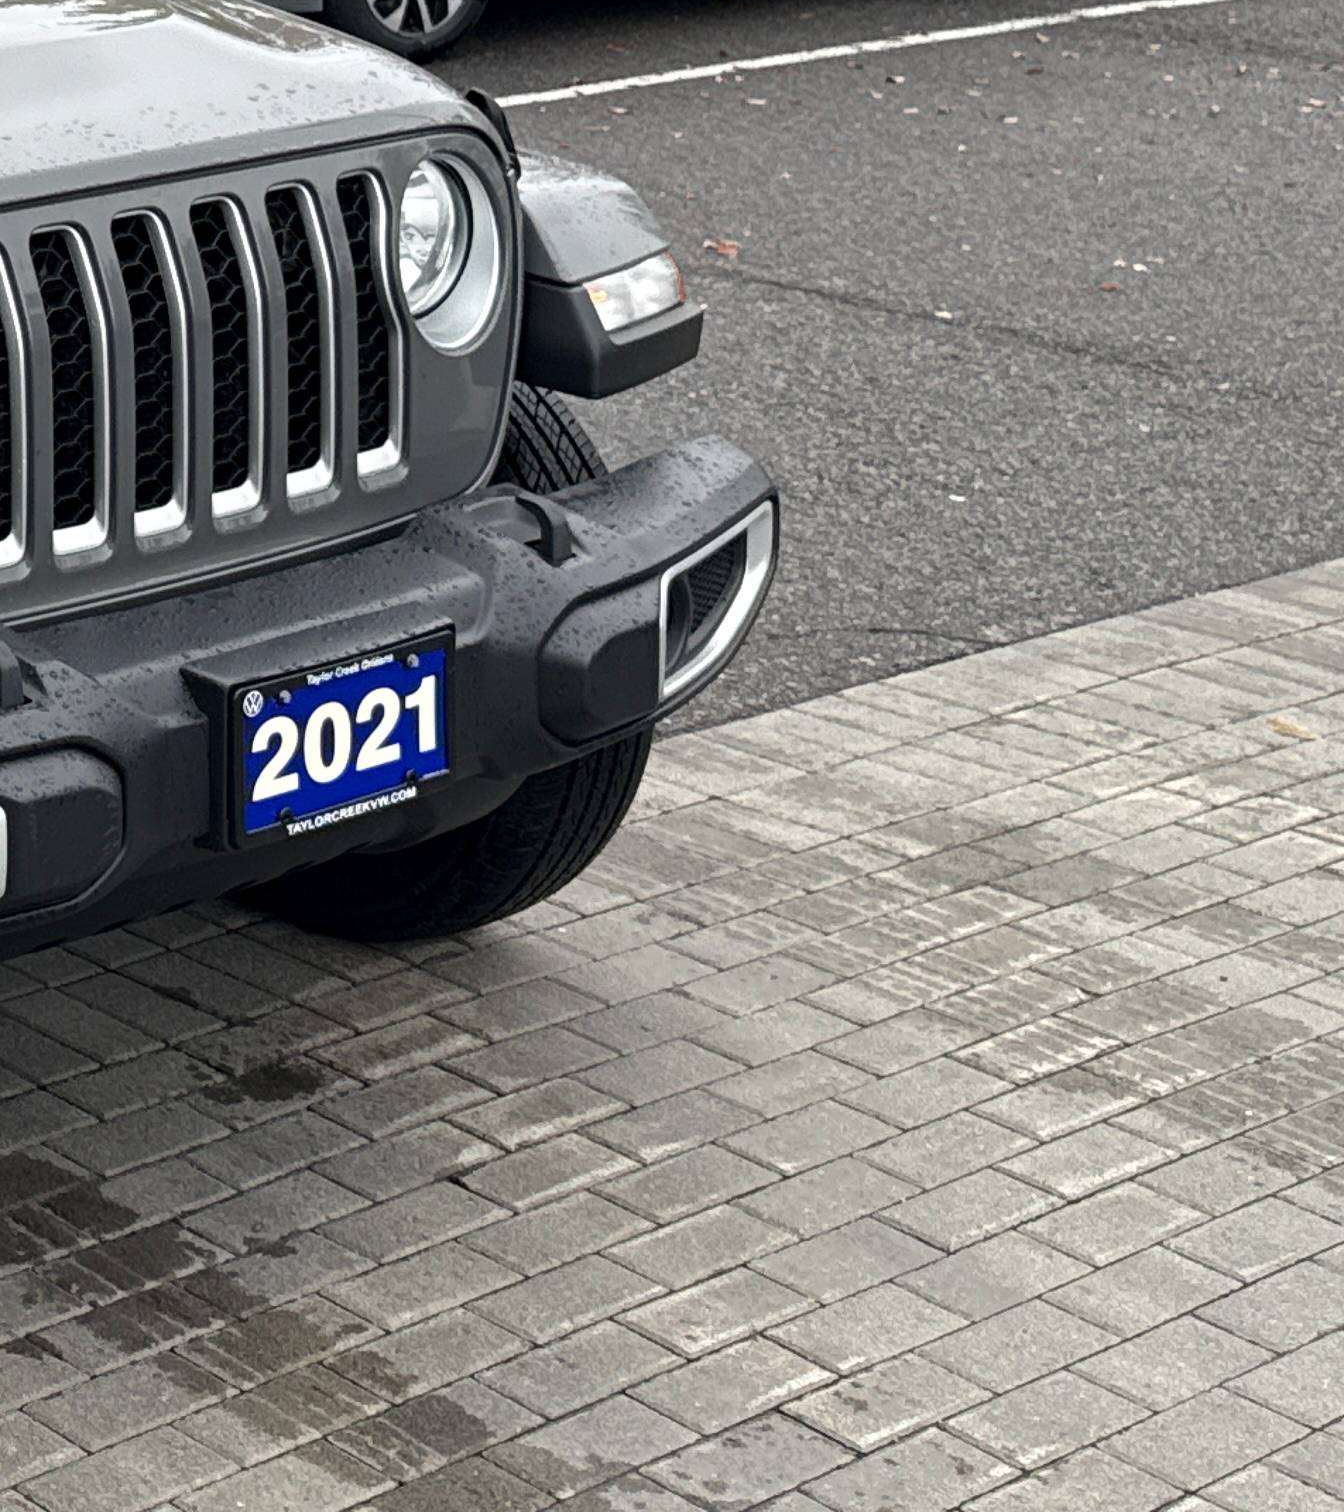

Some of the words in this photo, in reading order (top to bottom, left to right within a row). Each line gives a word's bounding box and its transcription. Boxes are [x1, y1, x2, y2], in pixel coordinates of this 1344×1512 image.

[306, 671, 334, 687] Taylor
[335, 662, 361, 678] Creek
[251, 674, 437, 803] 2021
[285, 785, 418, 837] TAYLORCREEKVW.COM
